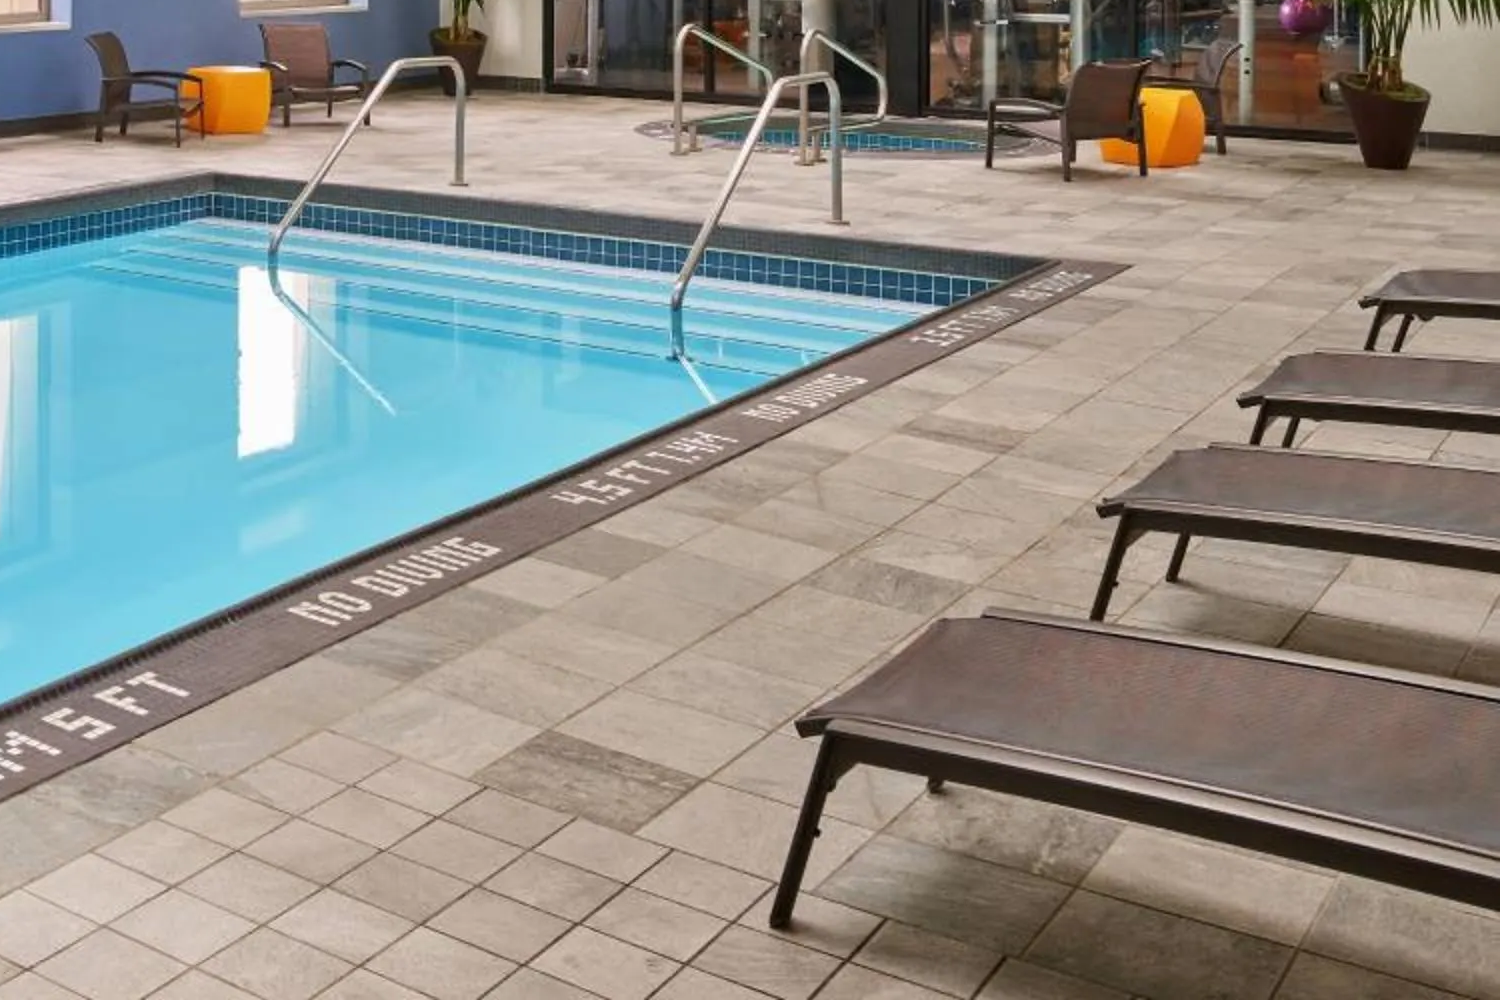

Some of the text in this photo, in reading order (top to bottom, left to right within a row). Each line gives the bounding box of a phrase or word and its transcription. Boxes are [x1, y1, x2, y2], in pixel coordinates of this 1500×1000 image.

[605, 459, 671, 486] FT
[287, 536, 502, 627] NO DIVING
